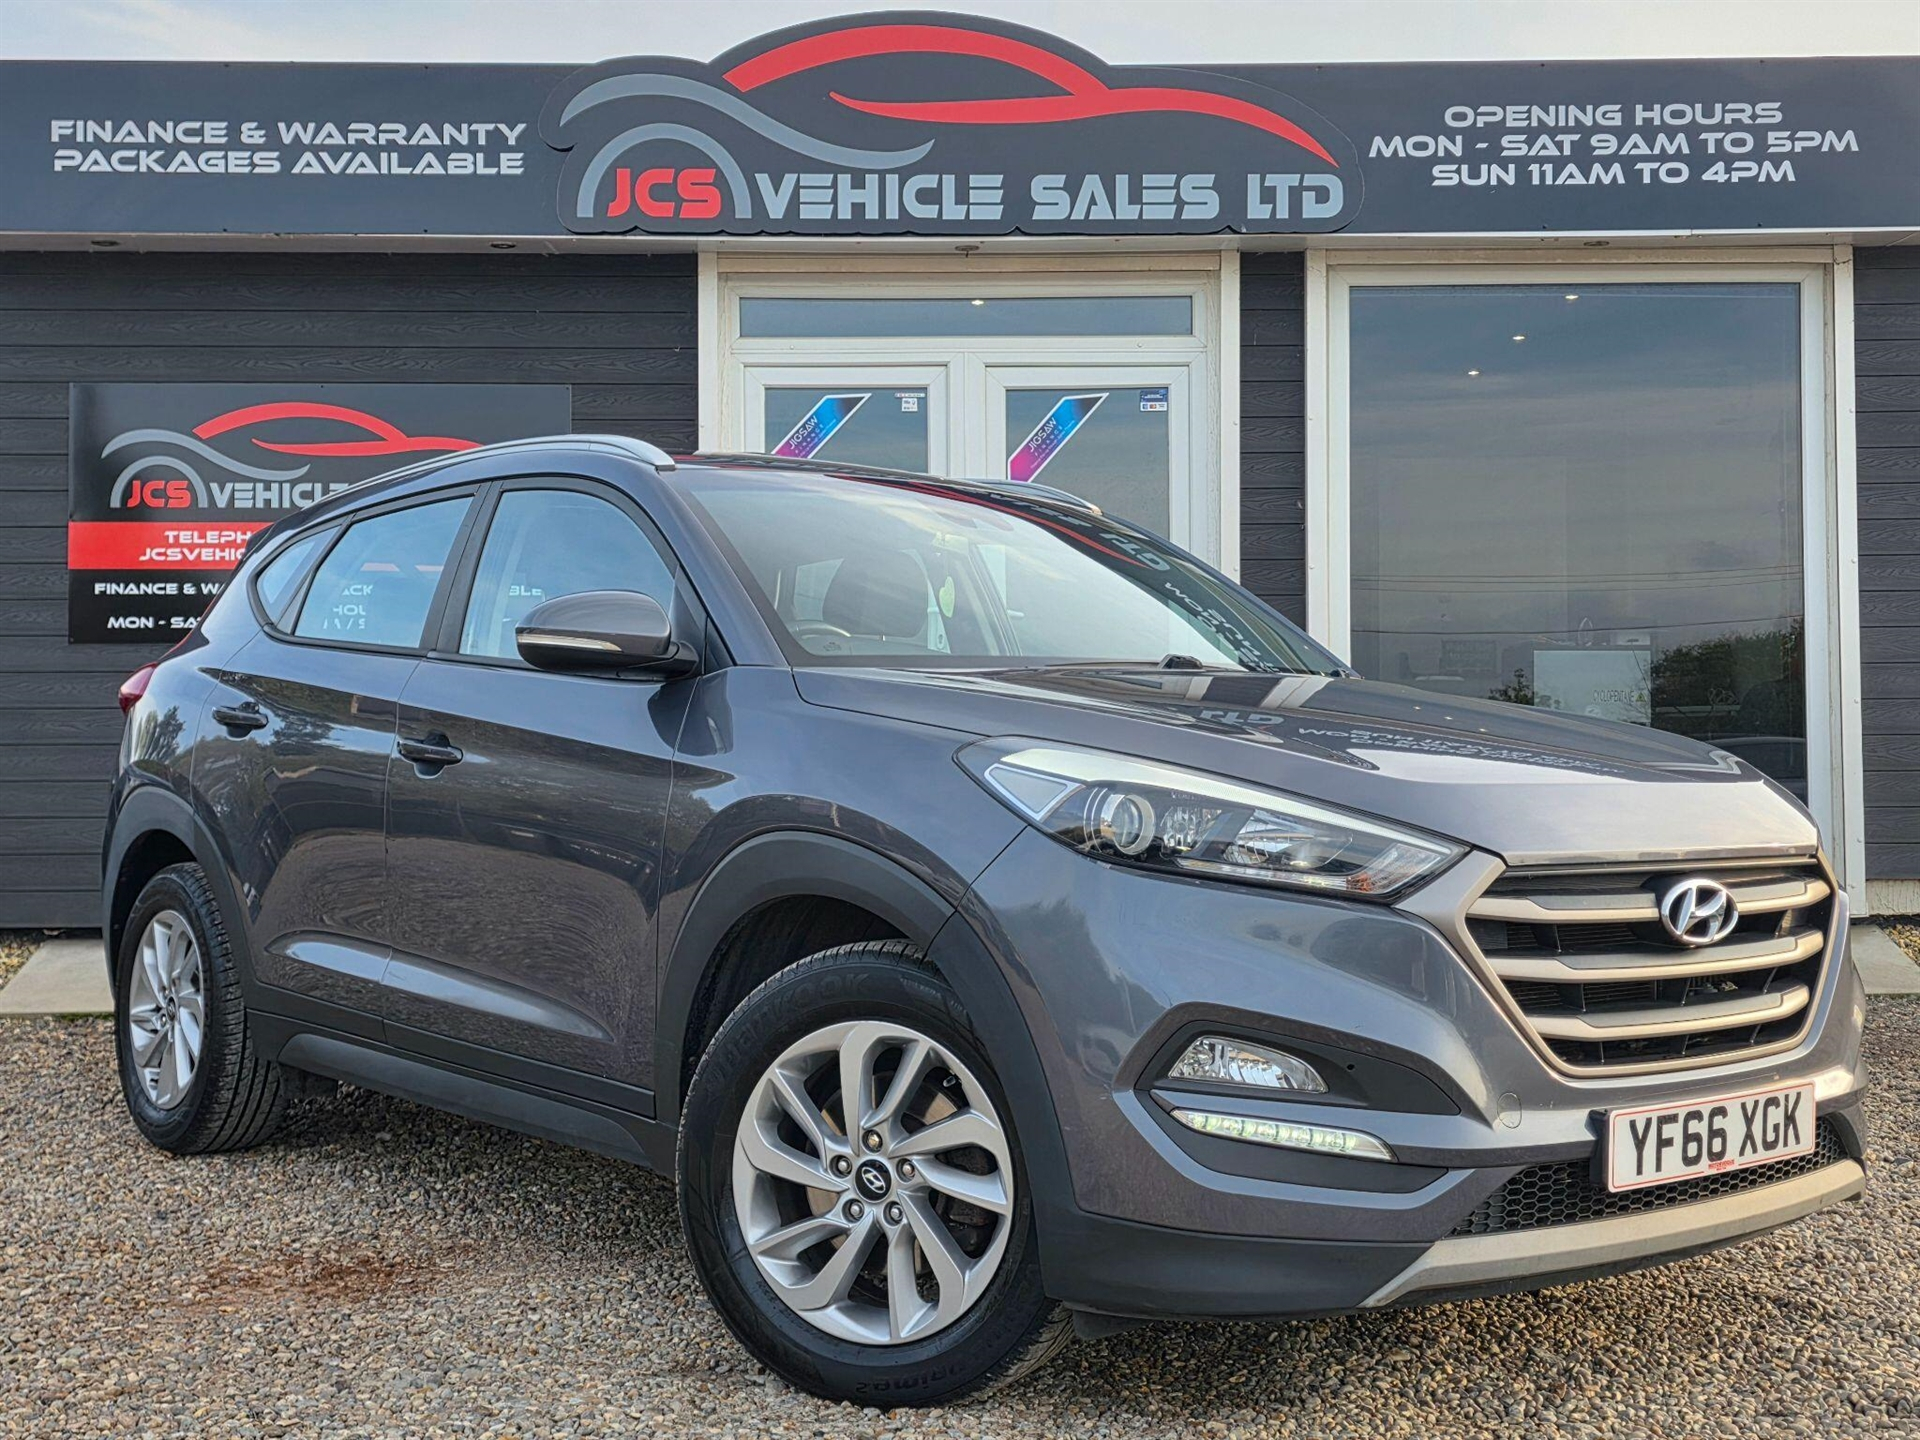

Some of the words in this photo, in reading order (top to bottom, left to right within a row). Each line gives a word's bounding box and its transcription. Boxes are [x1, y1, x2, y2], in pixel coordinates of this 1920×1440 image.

[1444, 104, 1623, 128] OPENING
[1635, 102, 1783, 126] HOURS
[50, 120, 229, 145] FINANCE
[240, 122, 266, 144] &
[277, 121, 527, 146] WARRANTY
[1369, 134, 1463, 158] MON
[1500, 133, 1581, 156] SAT
[1591, 131, 1694, 156] 9AM
[1699, 131, 1755, 154] TO
[1767, 129, 1859, 153] 5PM
[54, 149, 281, 174] PACKAGES
[291, 151, 524, 176] AVAILABLE
[1431, 163, 1515, 187] SUN
[1527, 162, 1625, 185] 11AM
[1634, 162, 1690, 184] TO
[1701, 160, 1796, 183] 4PM
[607, 168, 720, 219] JCS
[752, 174, 1004, 220] VEHICLE
[1031, 173, 1221, 221] SALES
[1246, 173, 1343, 220] LTD
[788, 415, 818, 450] JIGSAW
[1028, 417, 1057, 452] JIGSAW
[127, 481, 191, 508] JCS
[94, 582, 178, 596] FINANCE
[183, 583, 196, 596] &
[107, 616, 153, 629] MON
[1629, 1106, 1728, 1175] YF66
[1738, 1091, 1803, 1157] XGK
